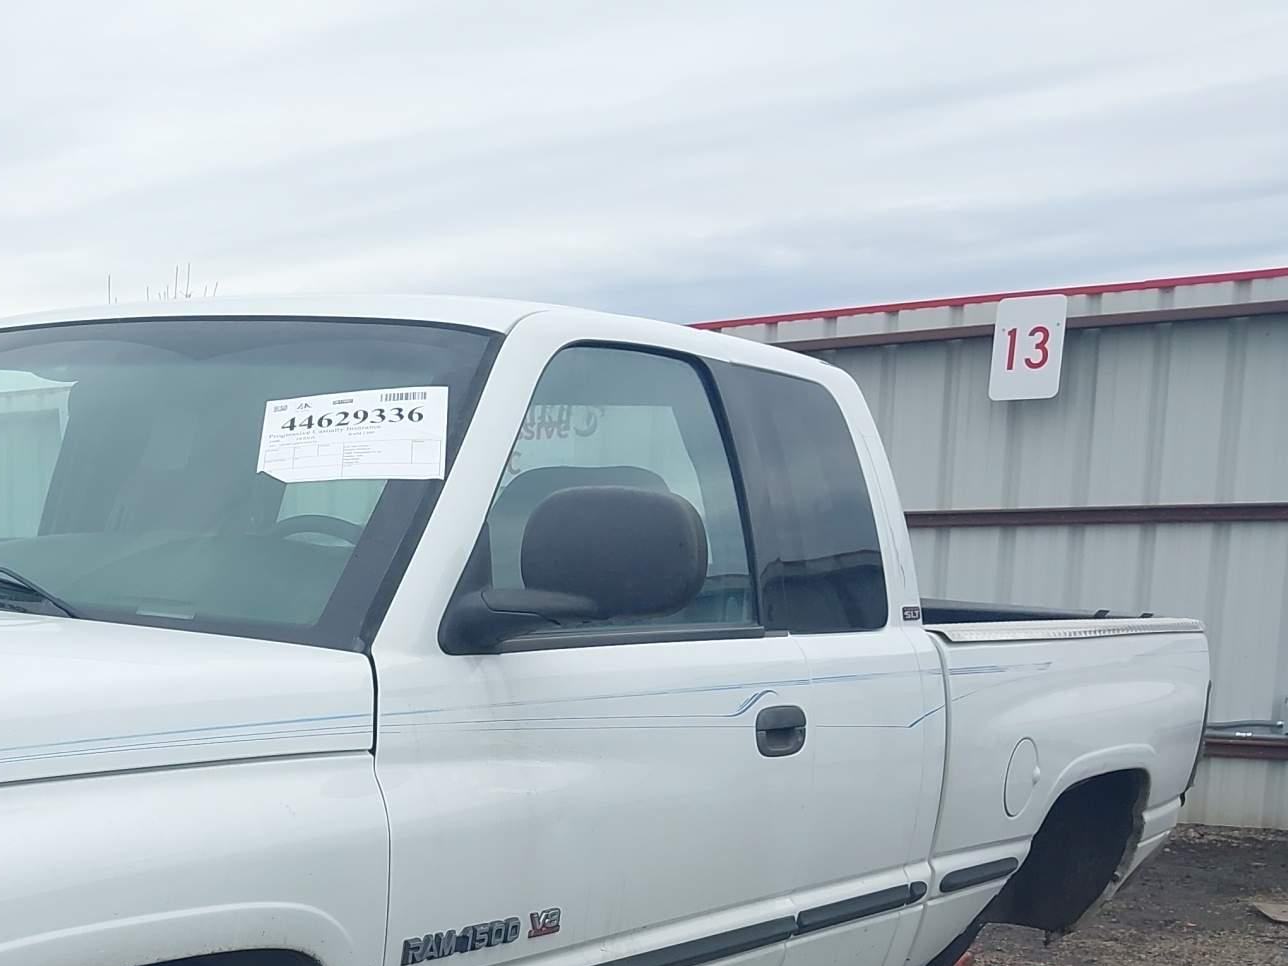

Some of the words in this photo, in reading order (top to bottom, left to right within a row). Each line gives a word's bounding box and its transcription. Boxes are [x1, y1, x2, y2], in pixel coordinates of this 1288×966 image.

[1006, 326, 1050, 371] 13
[281, 406, 424, 431] 44629336
[400, 928, 457, 966] RAM
